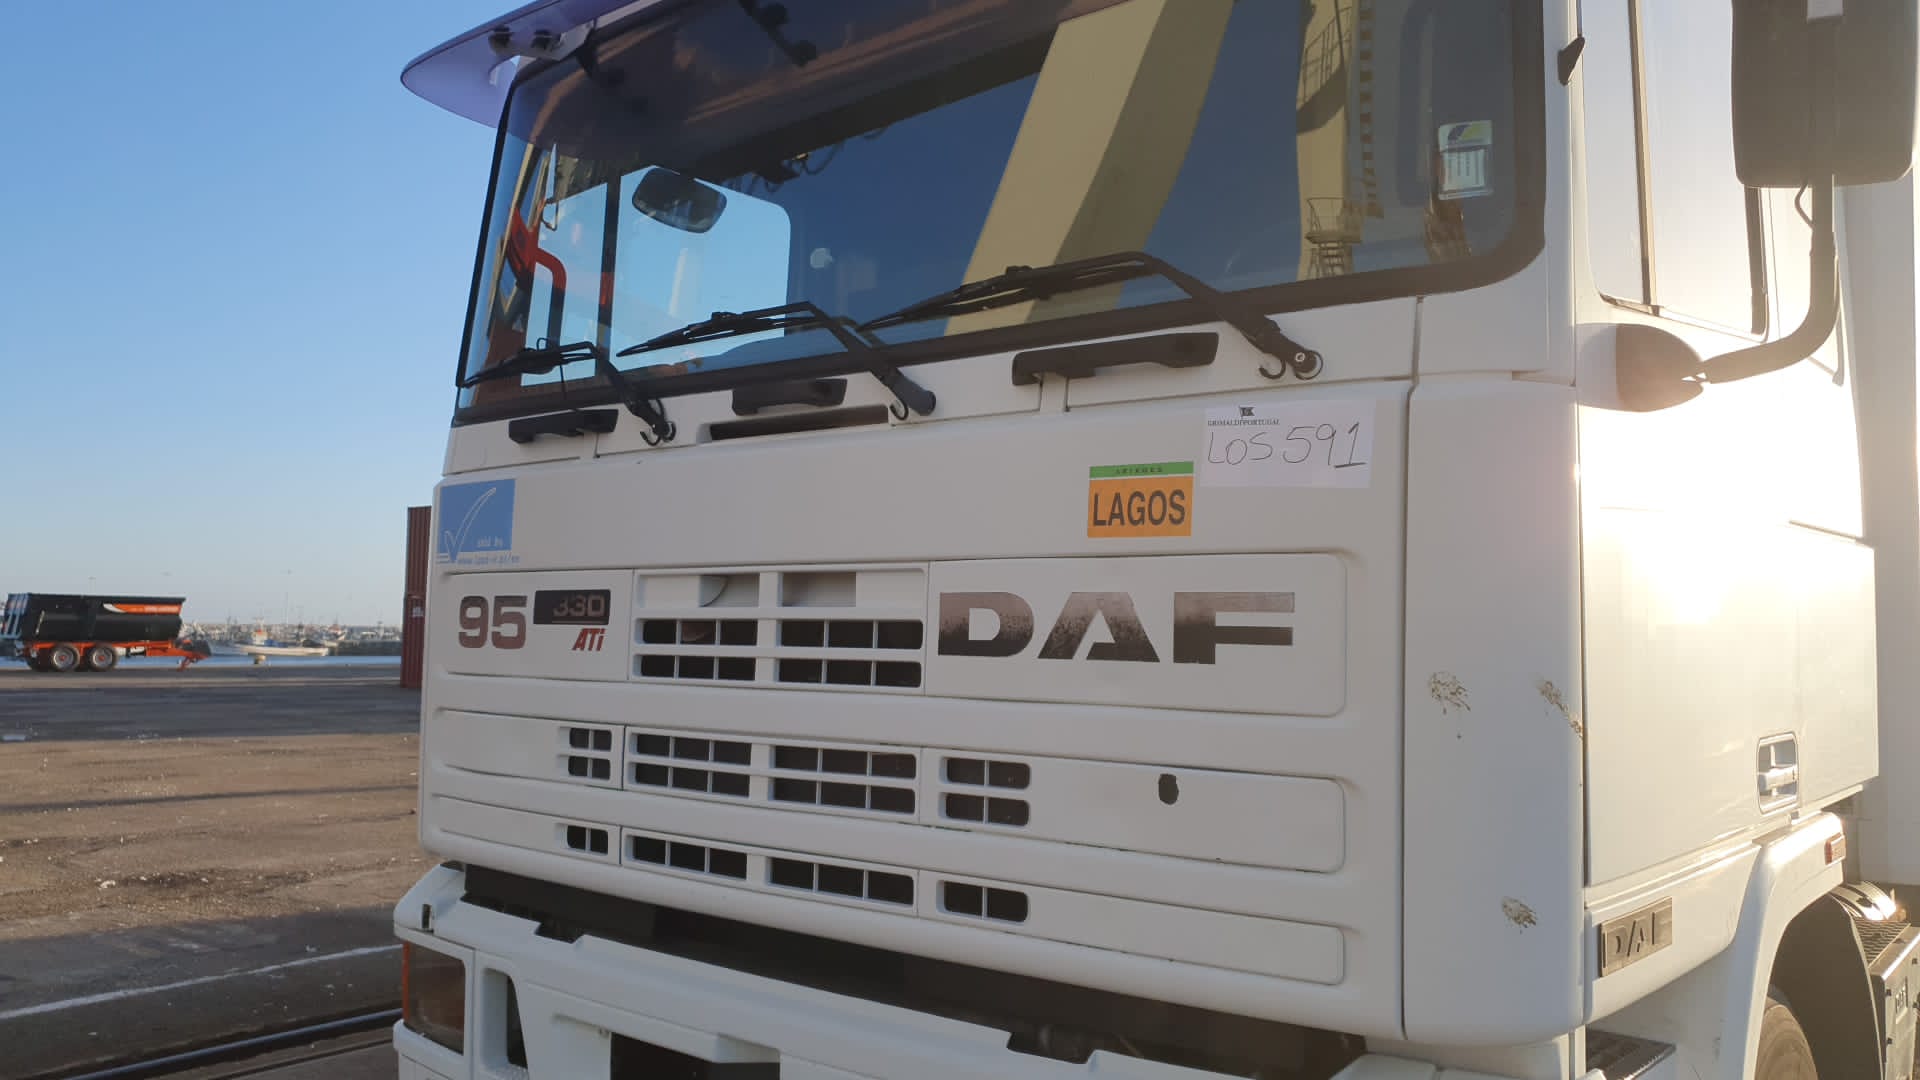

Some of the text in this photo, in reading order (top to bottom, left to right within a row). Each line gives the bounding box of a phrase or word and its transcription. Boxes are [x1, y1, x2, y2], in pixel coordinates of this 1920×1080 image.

[1208, 421, 1367, 468] LOS 591
[1093, 489, 1185, 526] LAGOS
[458, 594, 606, 650] 95 330
[938, 592, 1295, 665] DAF
